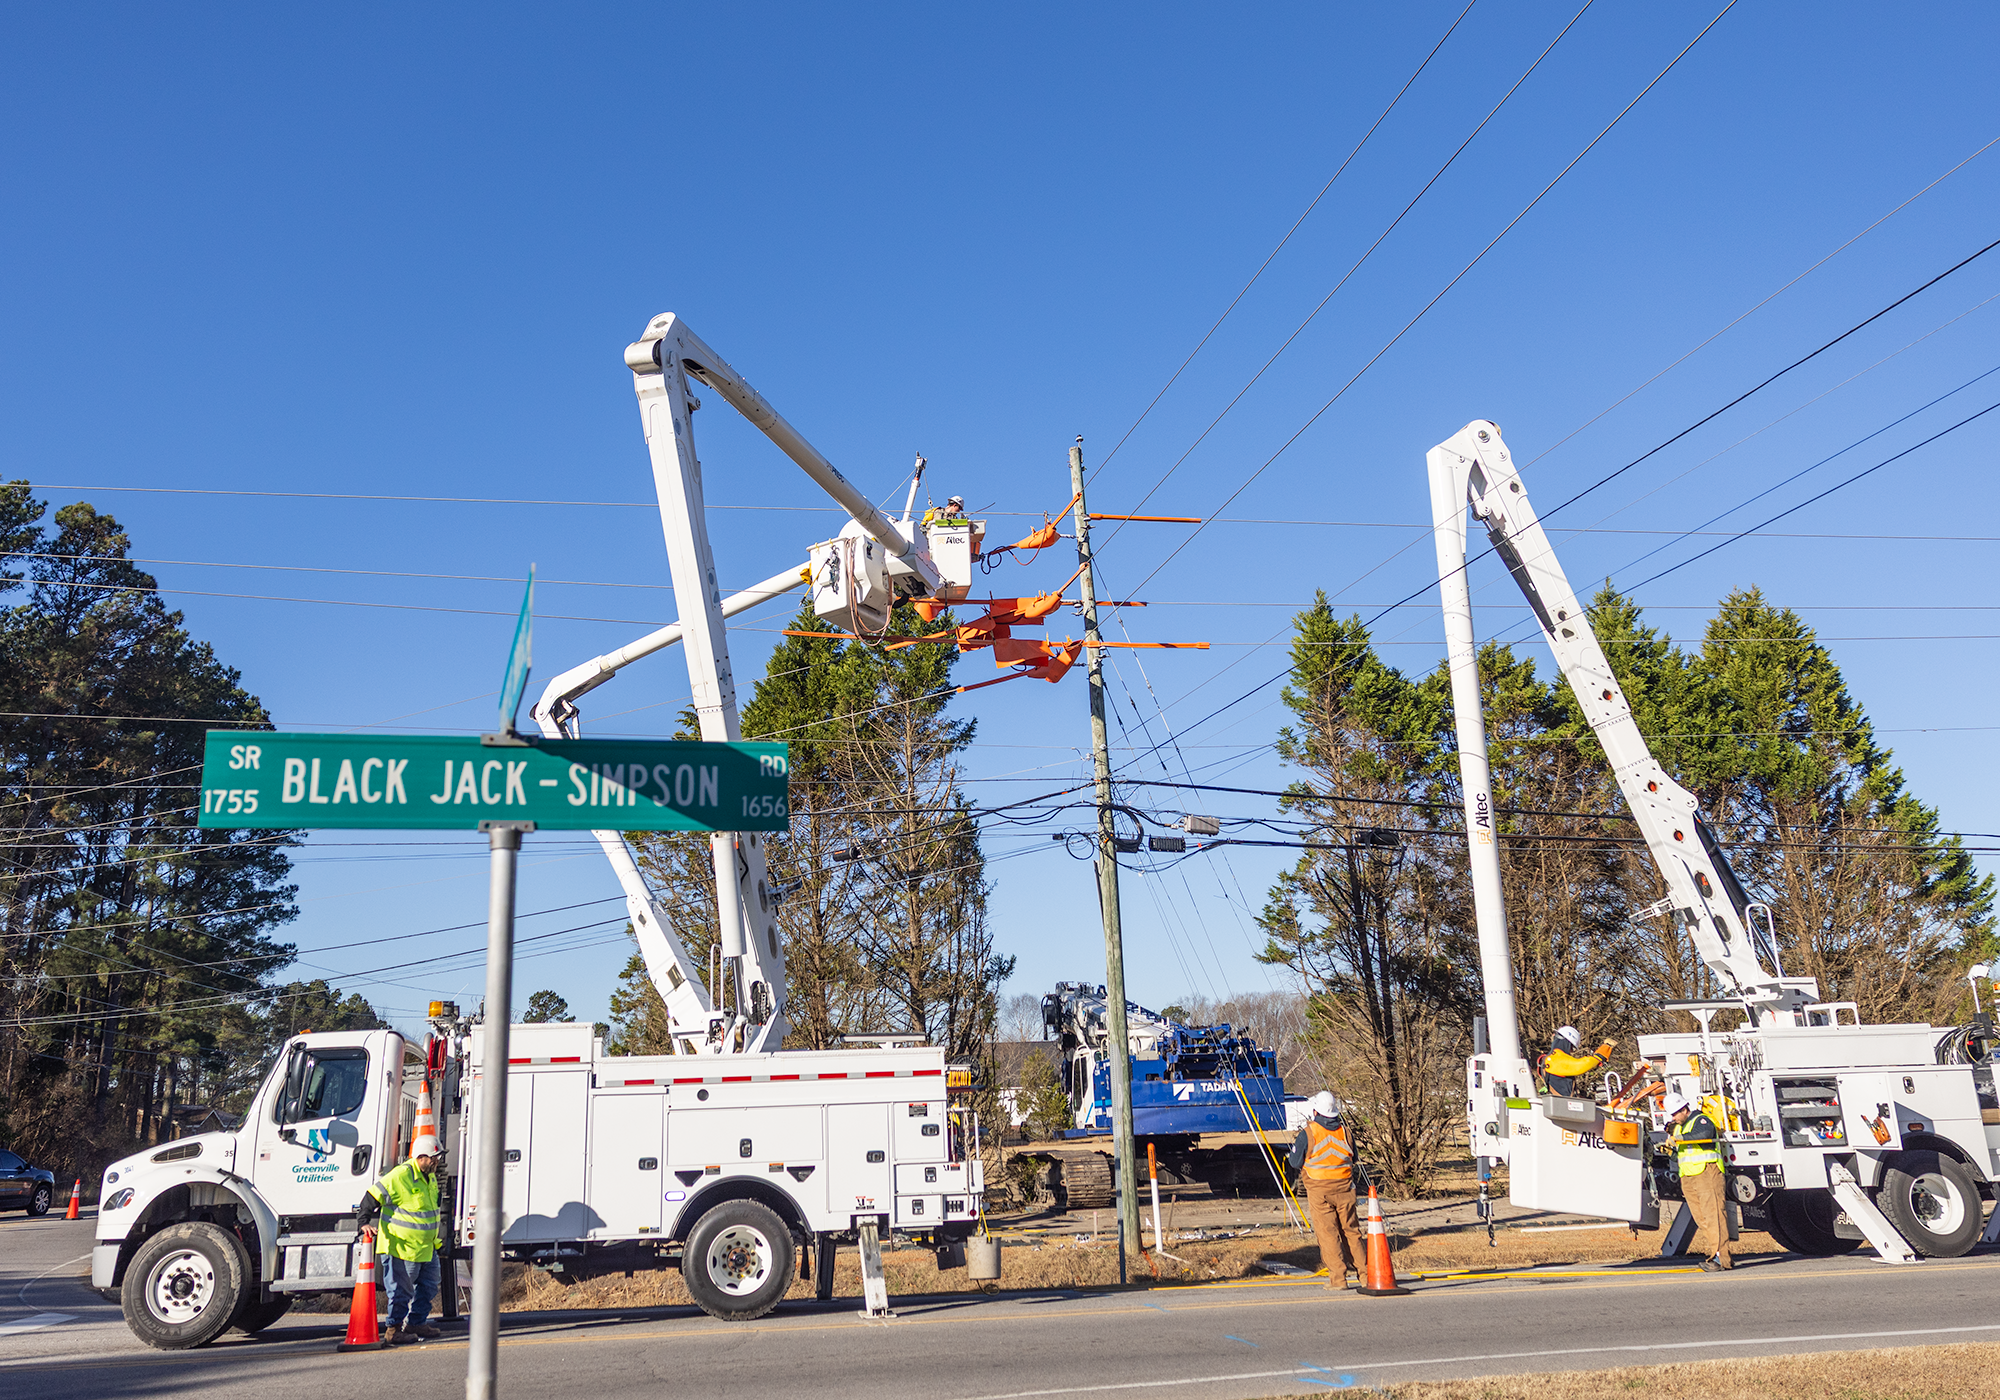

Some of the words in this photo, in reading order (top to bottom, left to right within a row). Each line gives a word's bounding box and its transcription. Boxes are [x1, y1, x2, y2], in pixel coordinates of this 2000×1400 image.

[229, 745, 262, 770] SR
[760, 754, 786, 777] RD
[282, 757, 409, 805] BLACK
[204, 789, 259, 814] 1755
[742, 795, 786, 817] 1656
[1475, 793, 1490, 829] Altec
[1200, 1081, 1243, 1092] TADANO
[292, 1164, 340, 1174] Greenville
[296, 1174, 334, 1183] Utilities
